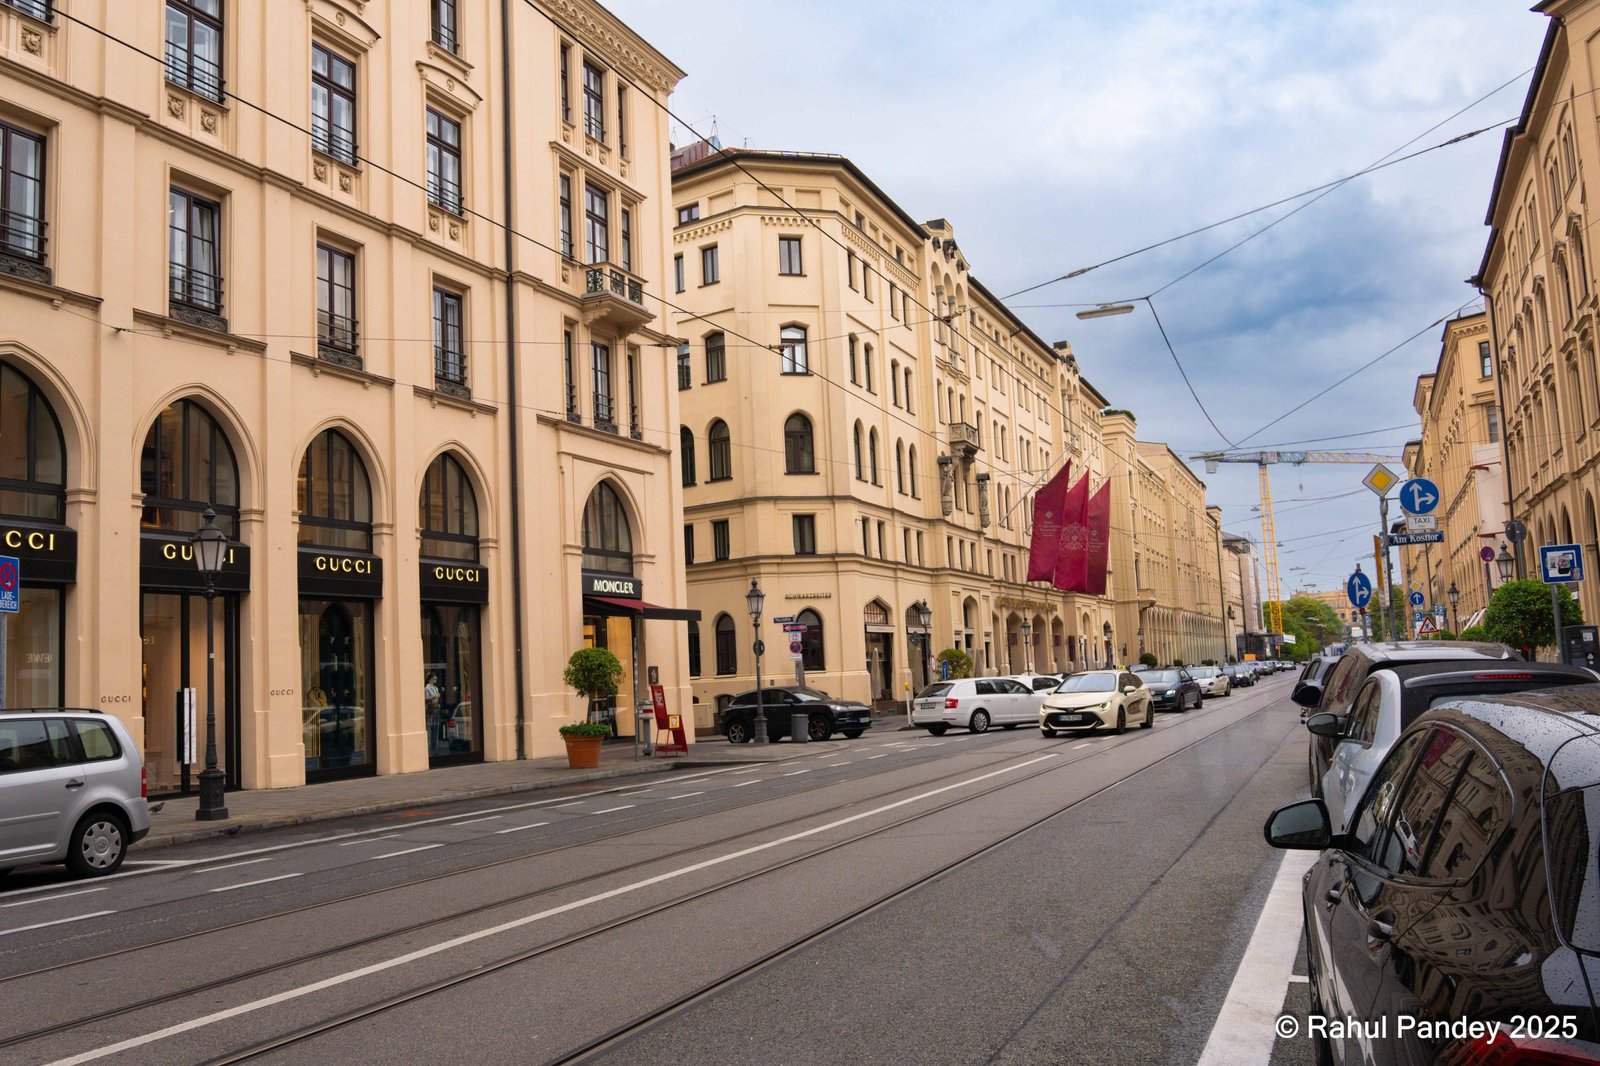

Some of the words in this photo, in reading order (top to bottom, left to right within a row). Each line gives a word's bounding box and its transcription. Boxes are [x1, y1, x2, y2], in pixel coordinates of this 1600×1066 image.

[1393, 535, 1407, 544] Am
[1410, 533, 1439, 543] Kosttor
[163, 543, 234, 564] GUI
[316, 556, 371, 574] GUCCI
[435, 566, 479, 582] GUCCI
[593, 579, 634, 594] MONCLER
[100, 695, 131, 703] GUCCI
